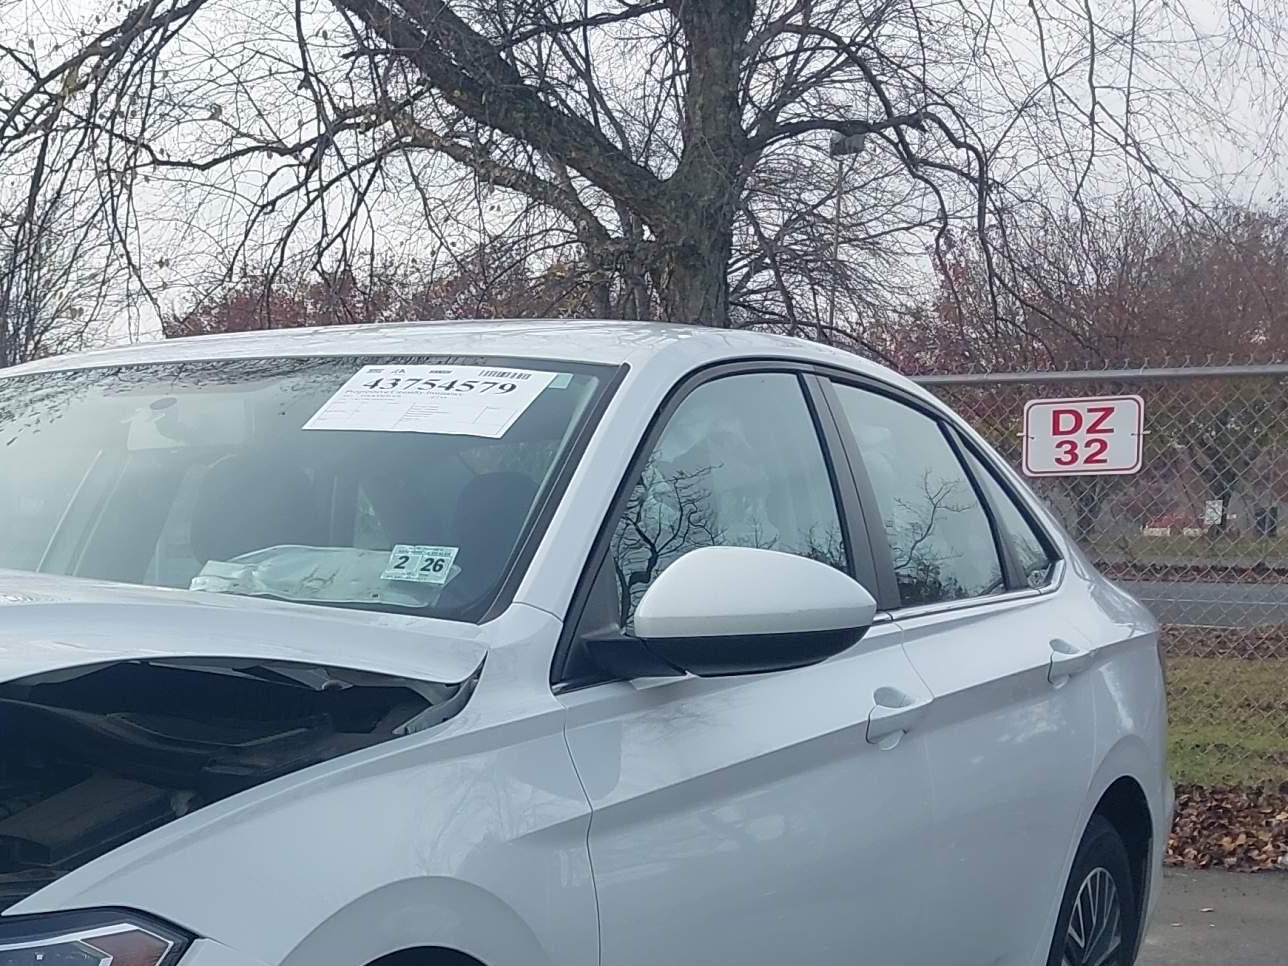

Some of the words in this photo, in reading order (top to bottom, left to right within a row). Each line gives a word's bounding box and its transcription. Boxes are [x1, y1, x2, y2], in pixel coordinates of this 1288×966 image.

[362, 378, 518, 395] 43754579
[1052, 406, 1115, 436] DZ
[1054, 438, 1109, 466] 32
[393, 555, 410, 570] 2
[420, 557, 445, 573] 26
